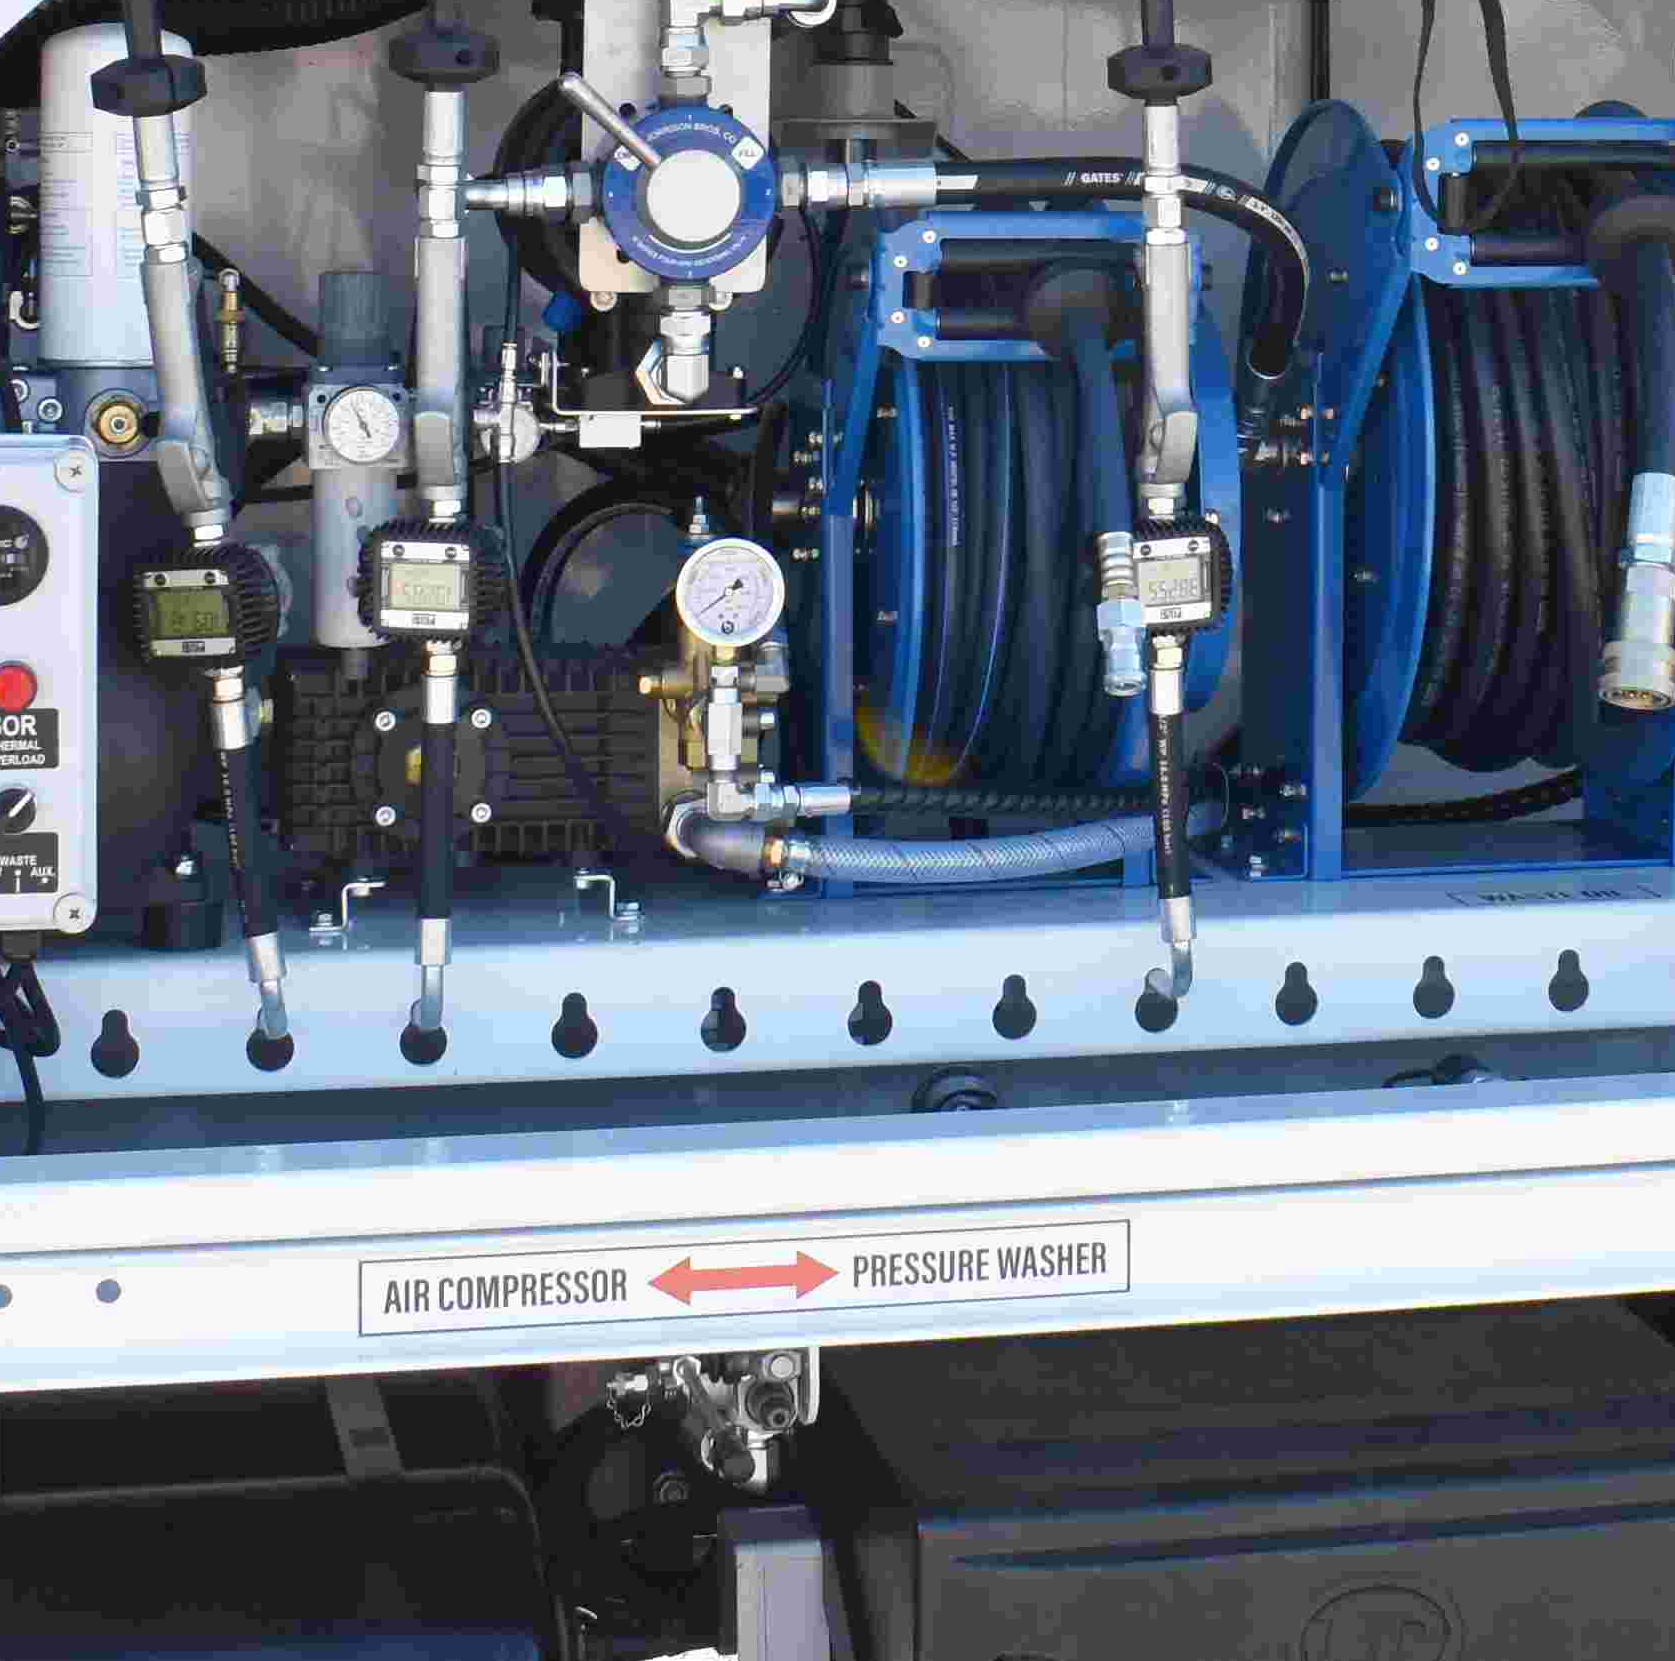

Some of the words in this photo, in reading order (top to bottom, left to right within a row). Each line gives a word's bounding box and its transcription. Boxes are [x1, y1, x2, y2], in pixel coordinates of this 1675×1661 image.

[0, 855, 37, 866] WASTE
[852, 1250, 990, 1288] PRESSURE
[997, 1242, 1108, 1280] WASHER
[384, 1279, 431, 1314] AIR
[437, 1268, 628, 1313] COMPRESSOR
